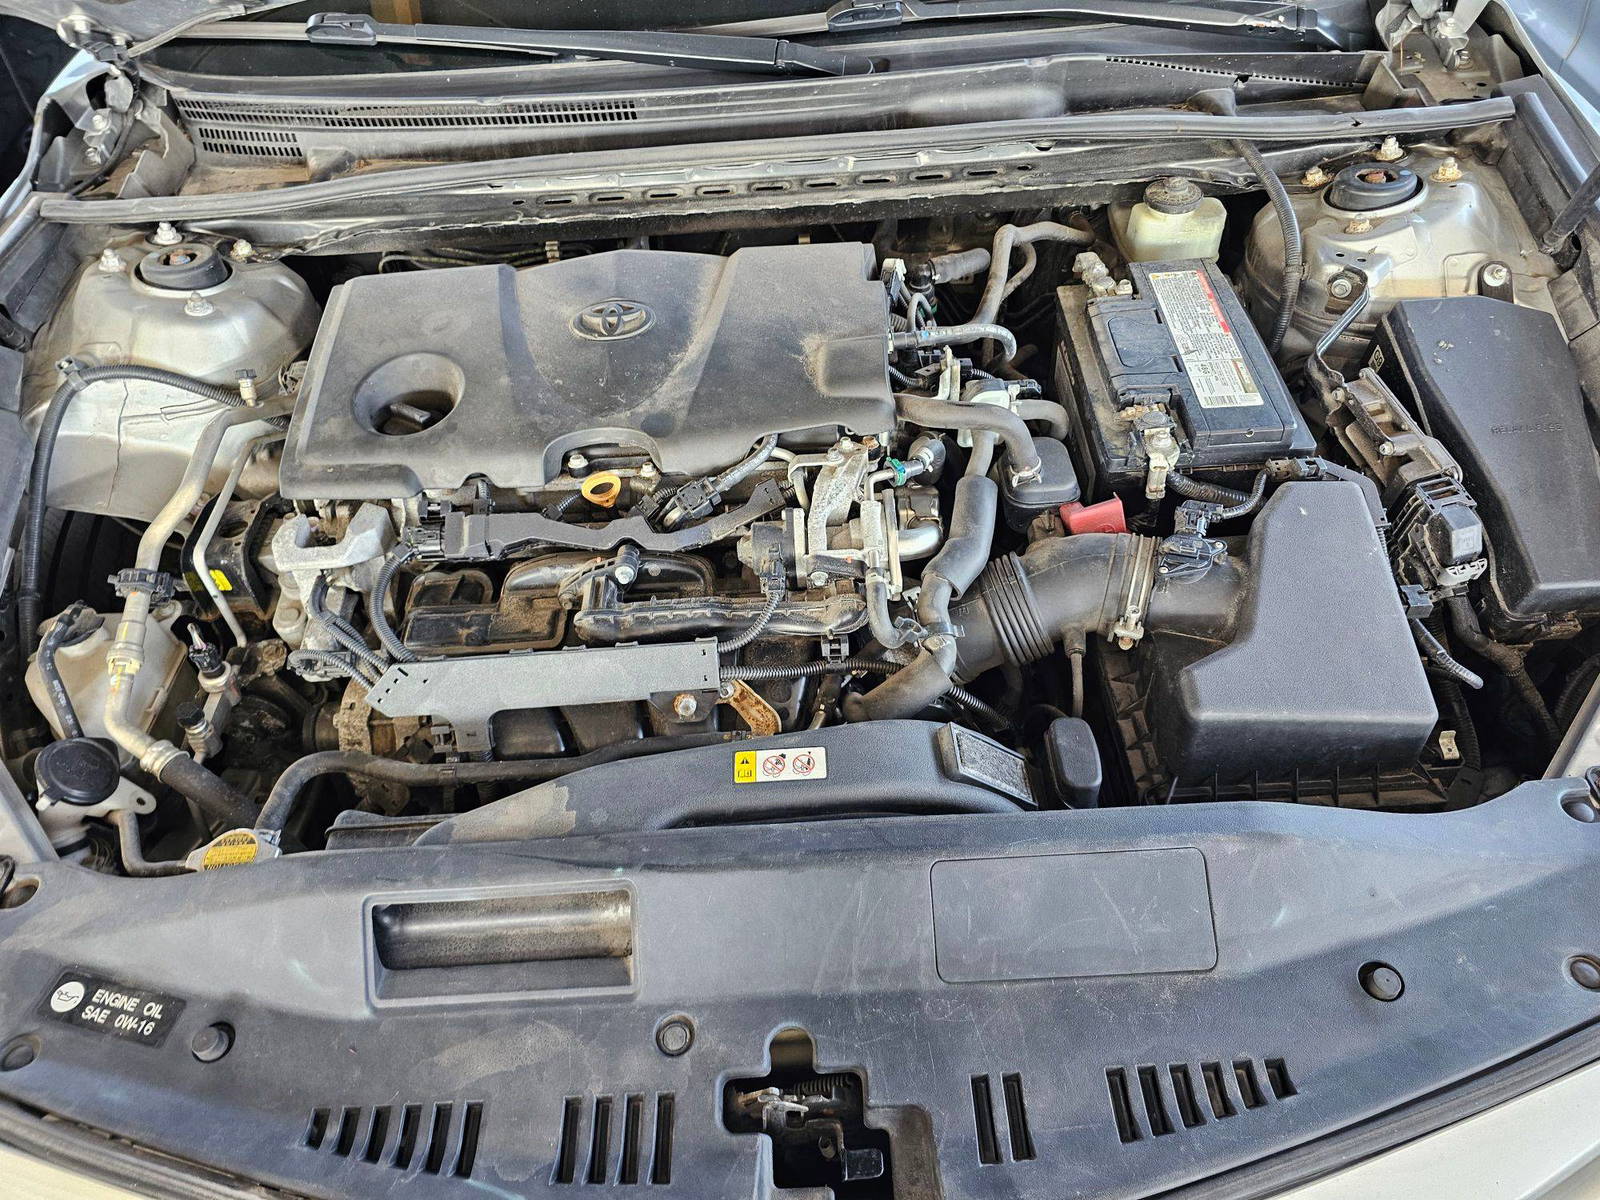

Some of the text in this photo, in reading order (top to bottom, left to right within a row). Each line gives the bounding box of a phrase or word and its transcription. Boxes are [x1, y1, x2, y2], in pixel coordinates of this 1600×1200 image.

[92, 988, 163, 1019] ENGINE OIL
[81, 1005, 155, 1036] SAE 0W-16
